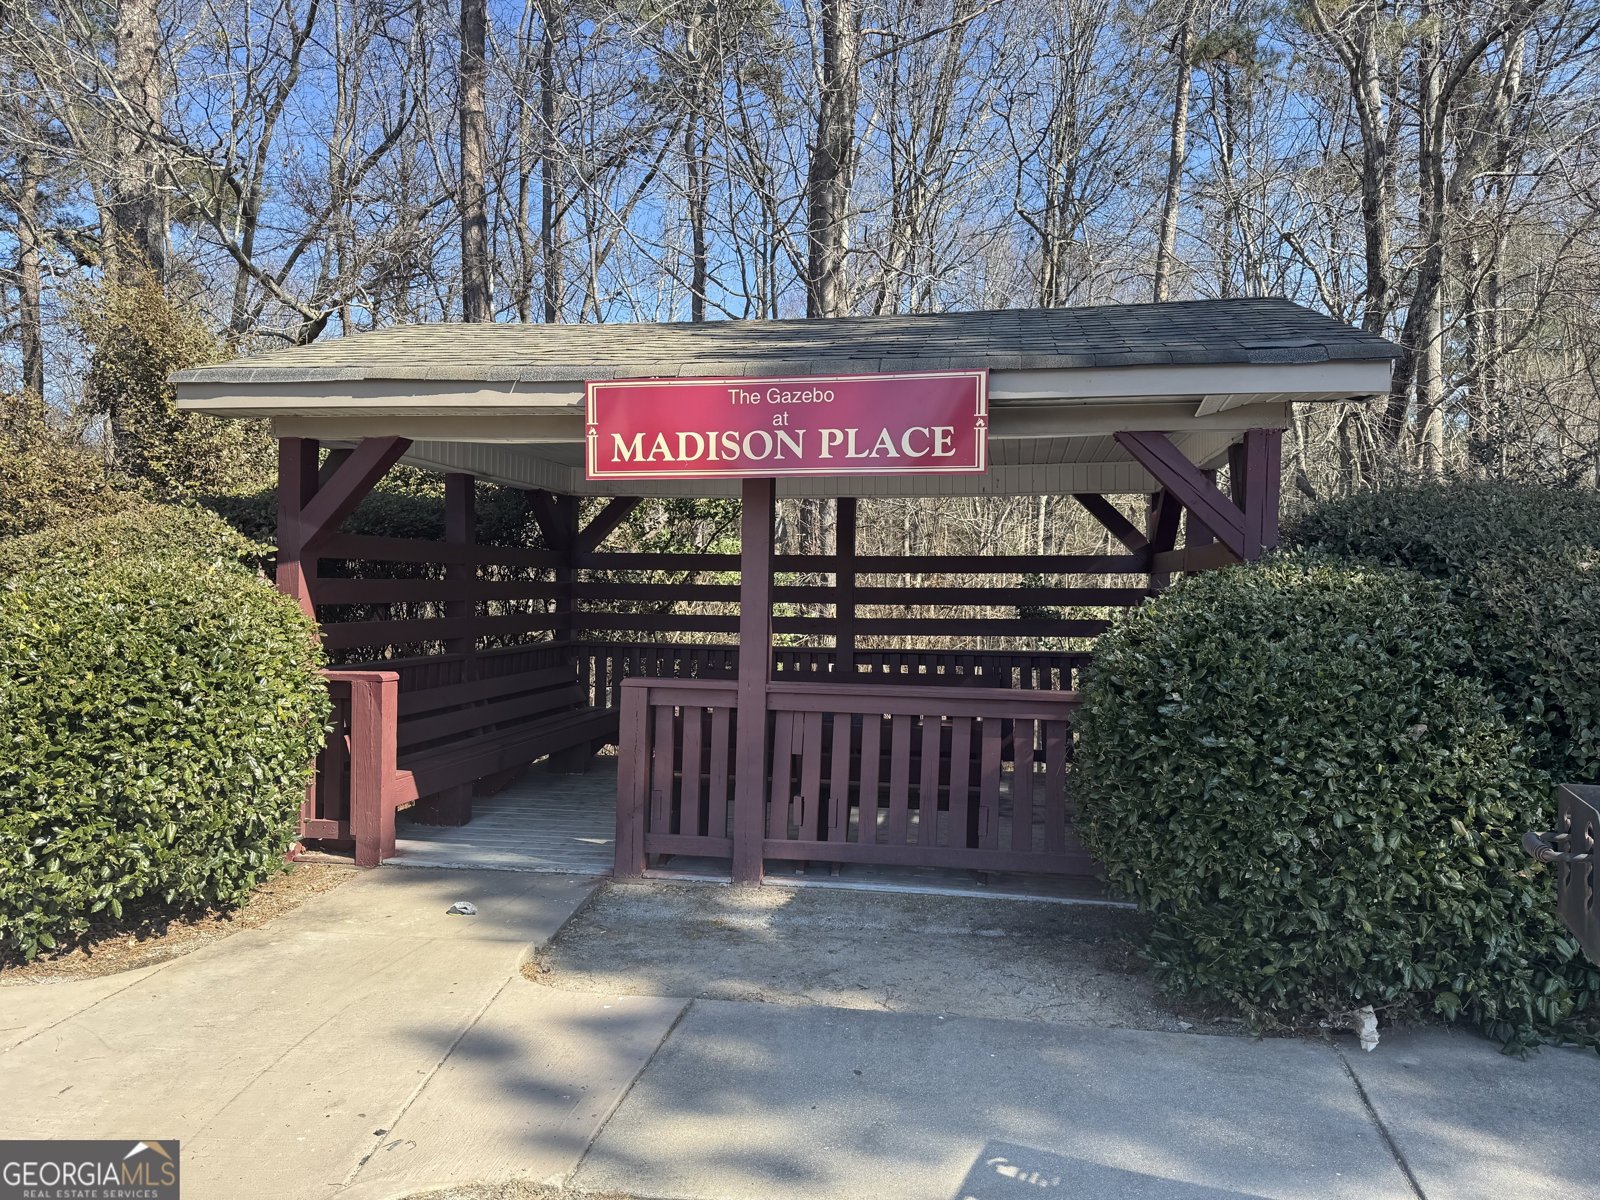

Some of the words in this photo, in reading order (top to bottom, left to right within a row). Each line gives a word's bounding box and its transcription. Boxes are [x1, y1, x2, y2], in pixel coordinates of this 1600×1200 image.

[727, 388, 761, 405] The
[766, 387, 835, 404] Gazebo
[772, 411, 789, 427] at
[610, 428, 806, 463] MADISON
[818, 425, 956, 459] PLACE
